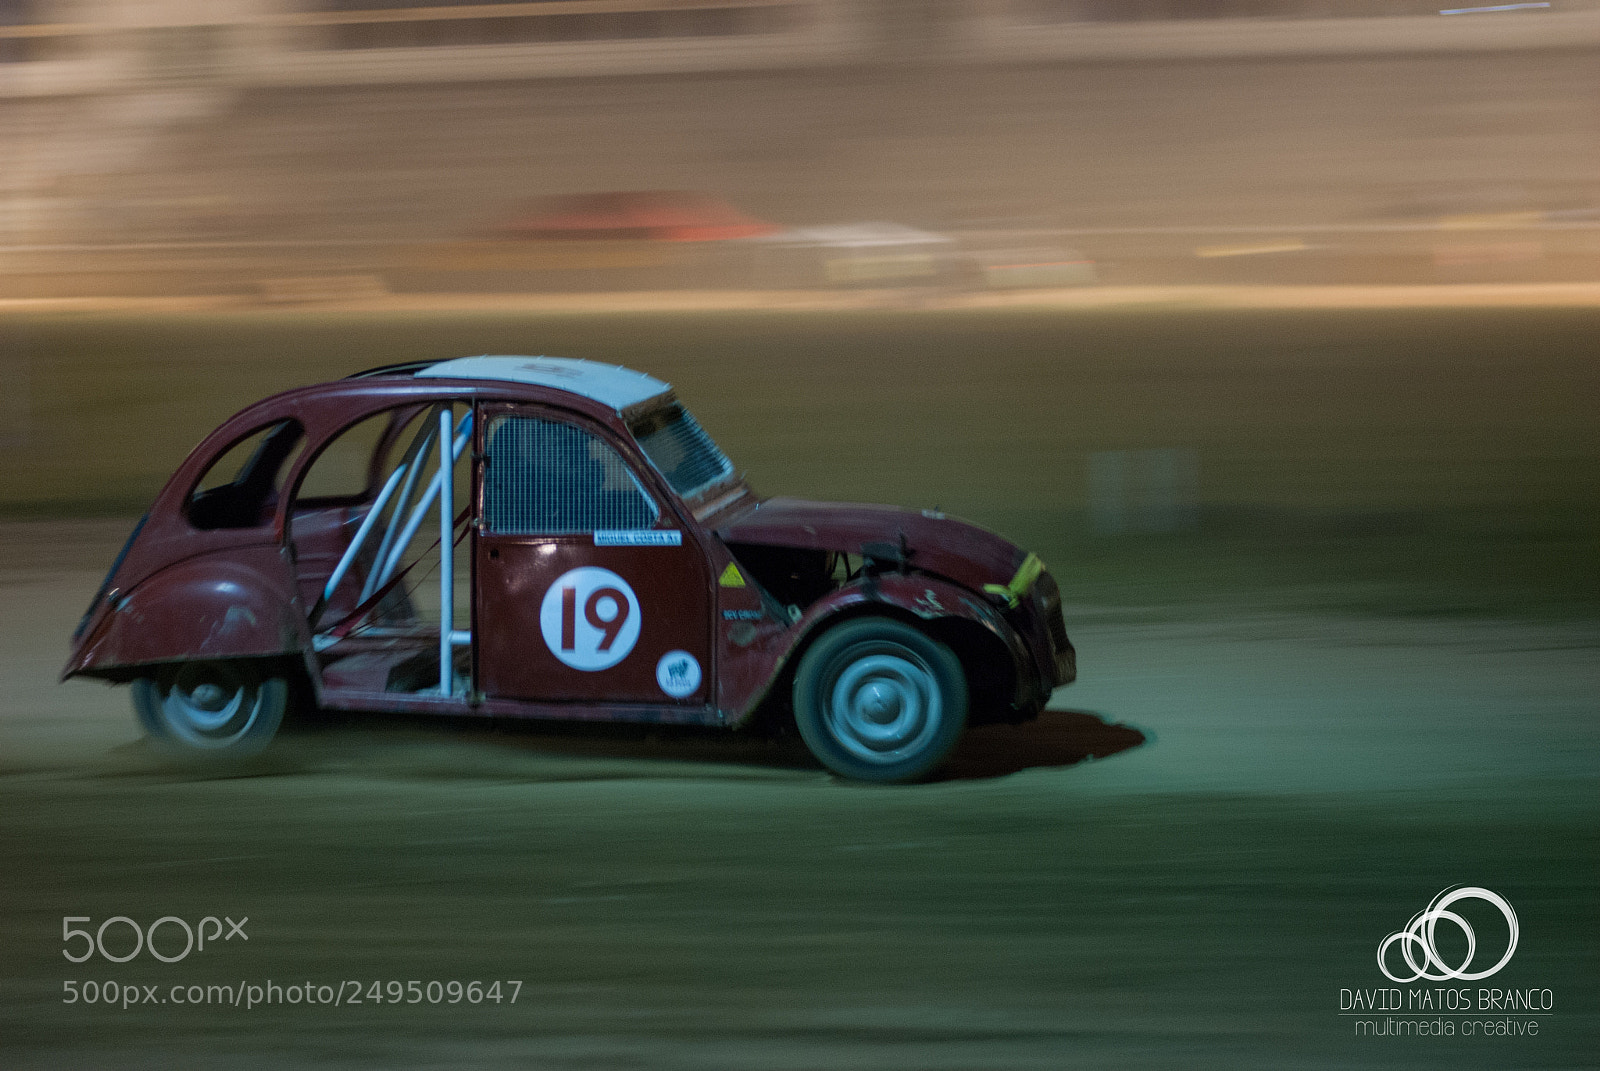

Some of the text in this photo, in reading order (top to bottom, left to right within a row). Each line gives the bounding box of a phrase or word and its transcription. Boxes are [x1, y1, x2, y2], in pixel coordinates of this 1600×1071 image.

[597, 532, 632, 545] MIGUEL
[634, 532, 665, 545] COSTA
[561, 585, 630, 653] 19
